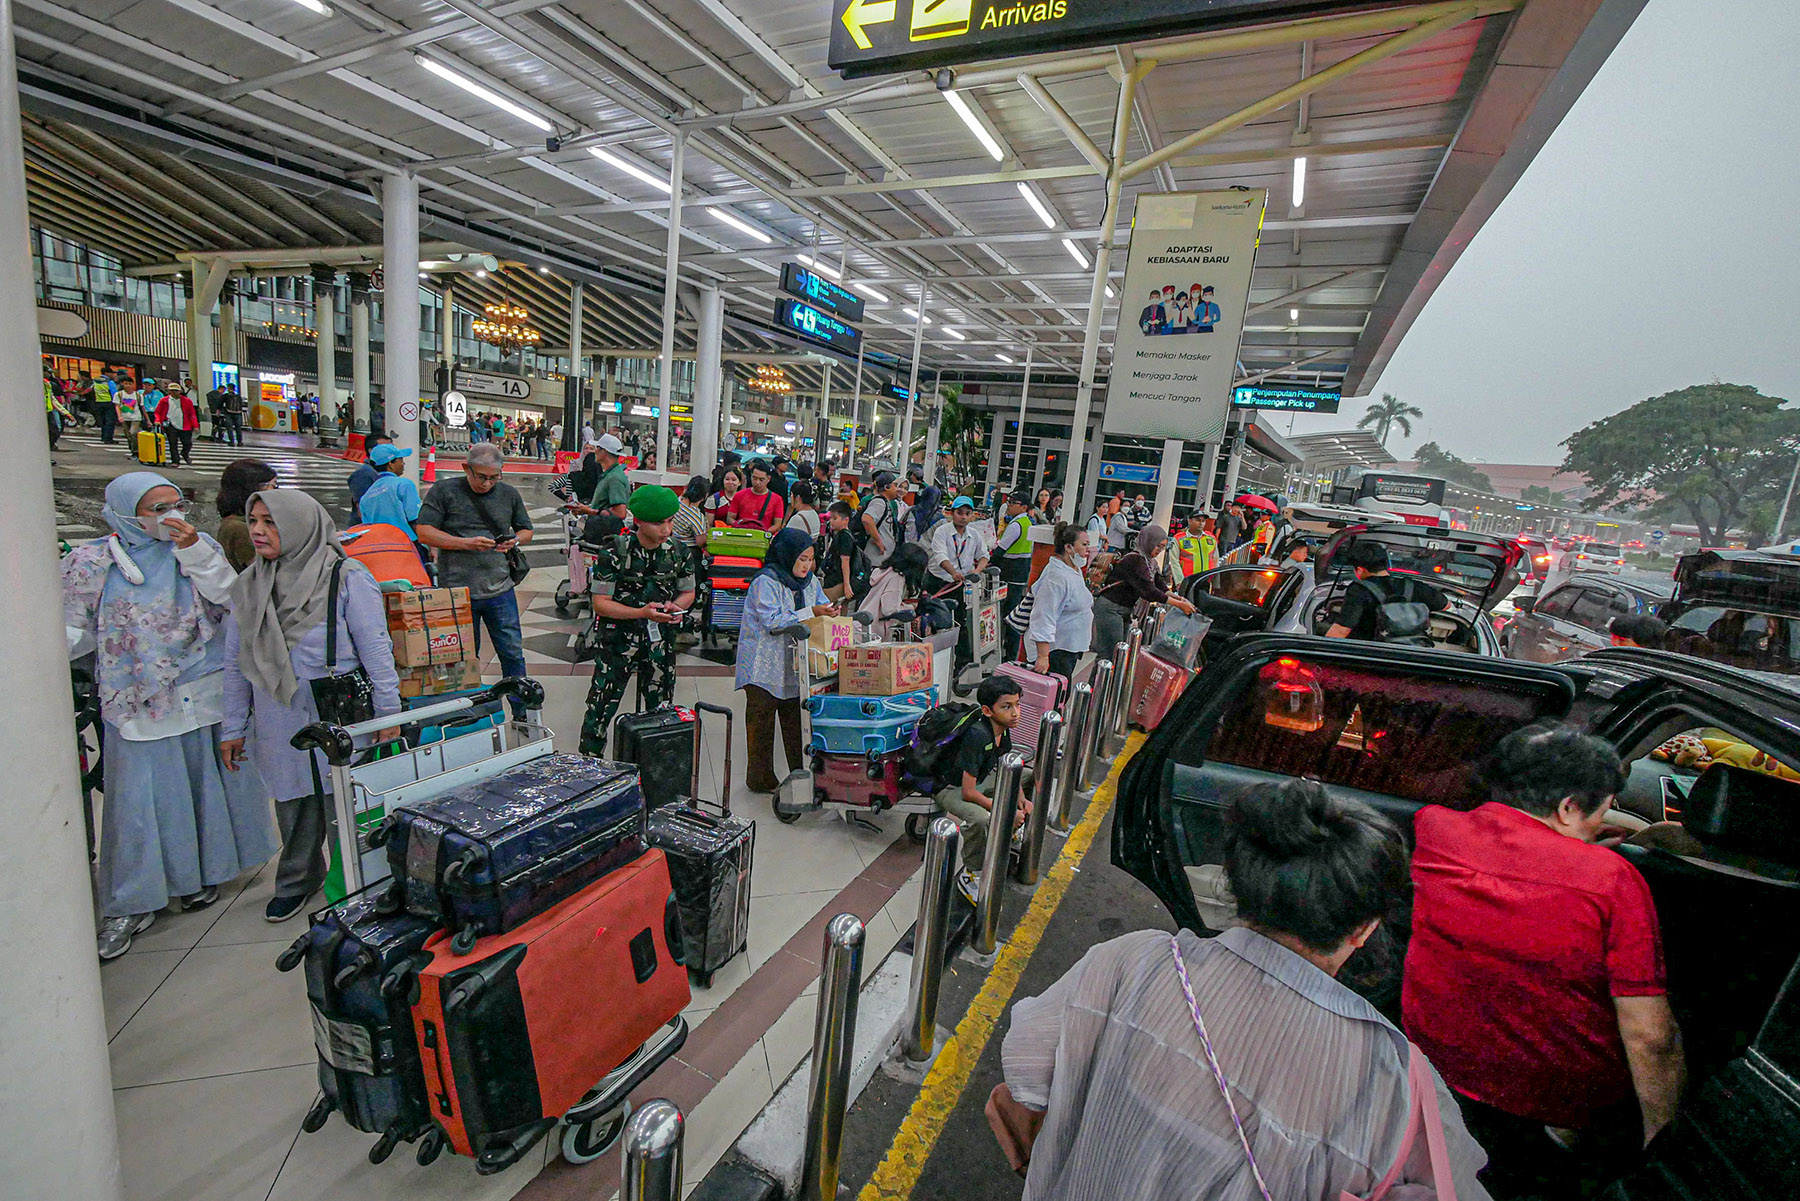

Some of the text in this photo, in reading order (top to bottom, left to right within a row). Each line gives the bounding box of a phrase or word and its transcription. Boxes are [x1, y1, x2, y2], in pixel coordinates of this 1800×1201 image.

[980, 0, 1067, 30] Arrivals
[1147, 256, 1230, 264] KEBIASAAN BARU
[816, 313, 830, 329] Ruang
[830, 319, 845, 334] Tunggu
[1136, 351, 1211, 361] Memakai Masker
[1132, 371, 1198, 381] Menjaga Jarak
[502, 380, 521, 396] 1A
[1129, 391, 1202, 403] Mencuci Tangan
[1252, 388, 1340, 401] Penjemputan Penumpang
[447, 401, 465, 413] 1A
[1251, 397, 1315, 409] Passenger Pick up
[430, 636, 457, 649] SunCo
